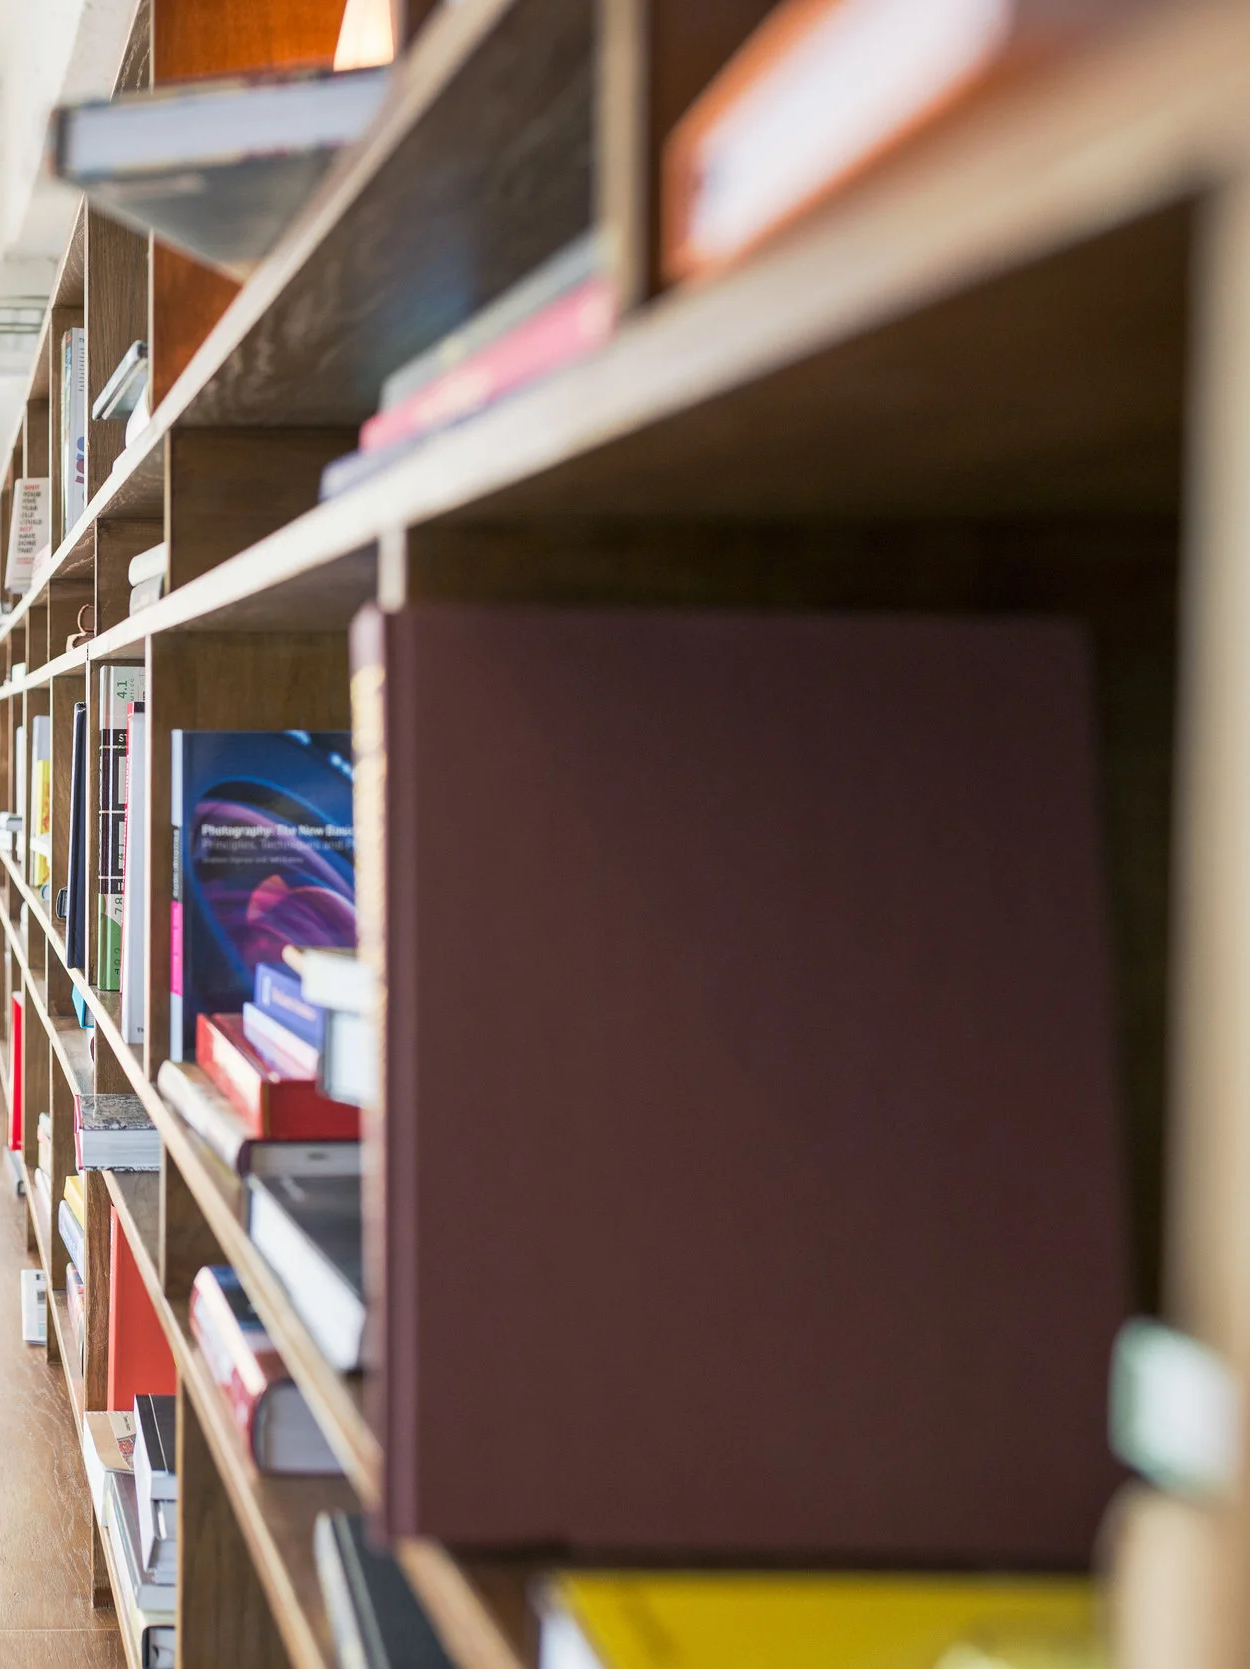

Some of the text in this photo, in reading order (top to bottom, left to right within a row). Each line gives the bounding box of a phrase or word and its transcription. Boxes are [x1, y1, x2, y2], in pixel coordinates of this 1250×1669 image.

[116, 680, 128, 699] 4.1
[276, 824, 297, 836] The
[298, 824, 324, 836] New
